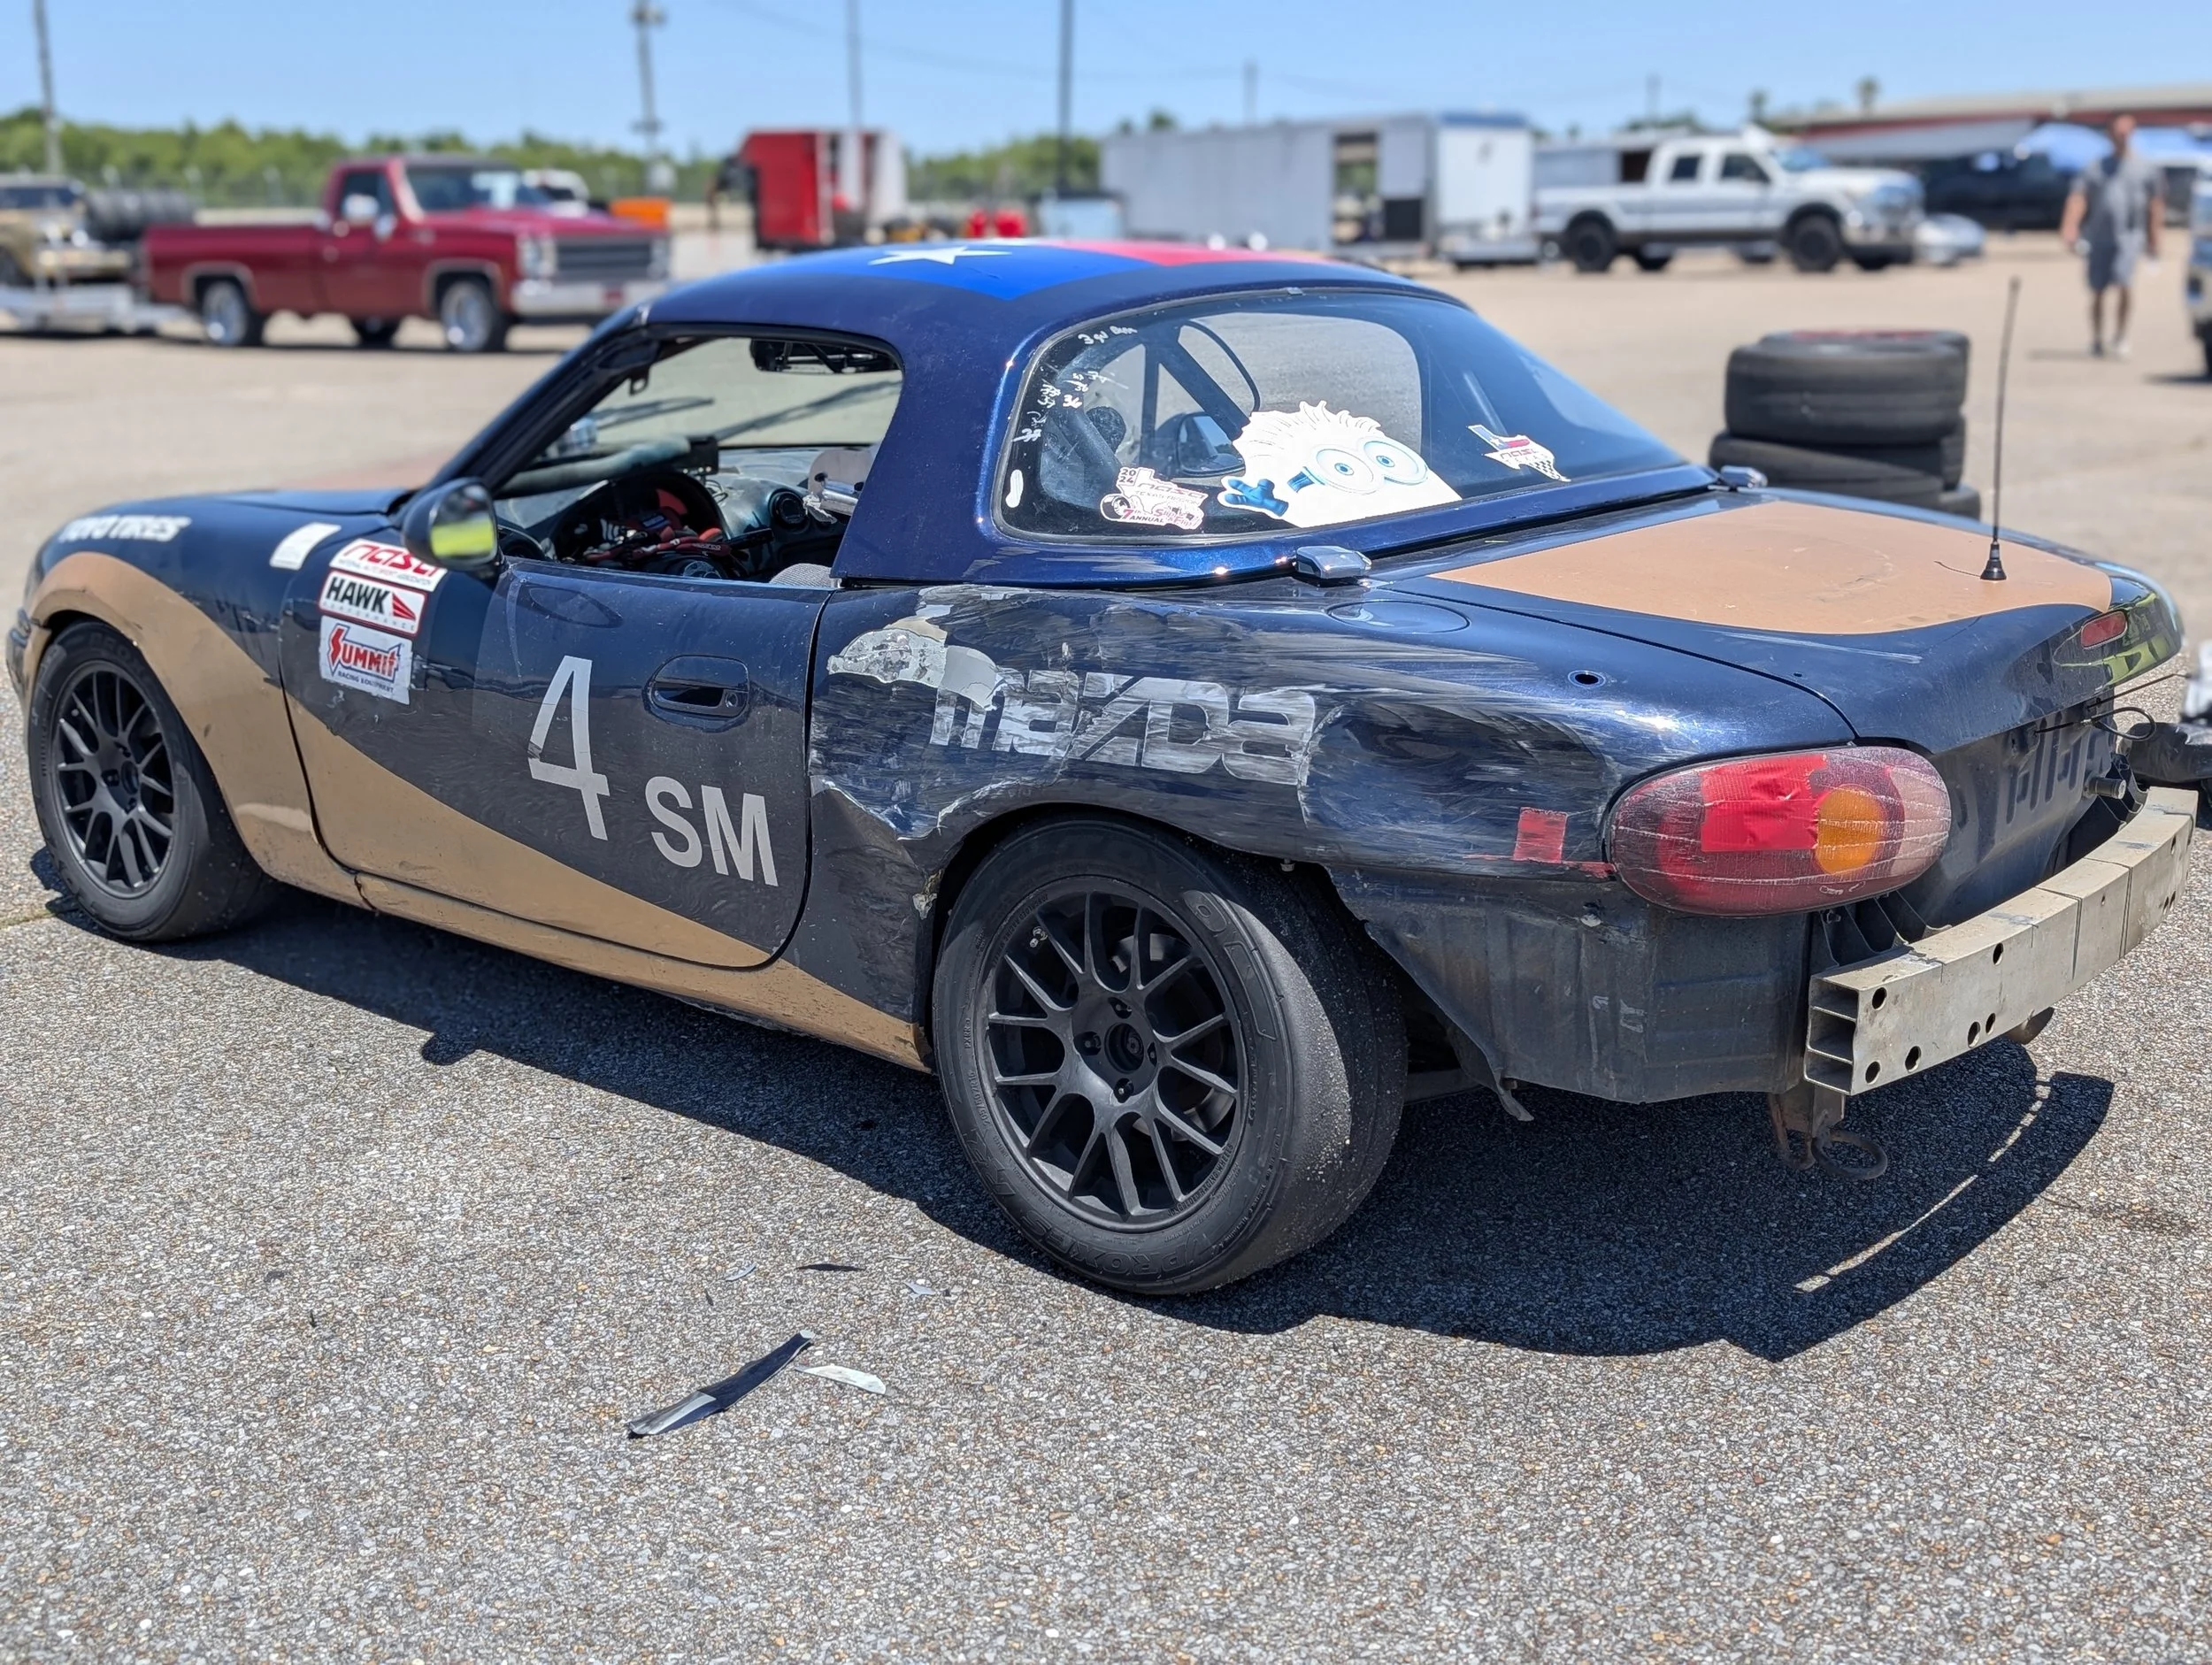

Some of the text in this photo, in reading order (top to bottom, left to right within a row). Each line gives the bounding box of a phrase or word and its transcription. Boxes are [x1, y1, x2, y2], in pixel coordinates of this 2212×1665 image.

[1121, 468, 1137, 477] 20
[1138, 483, 1205, 499] nasa
[343, 543, 440, 577] nasa
[326, 576, 390, 615] HAWK
[338, 670, 359, 683] RACING
[526, 655, 779, 887] 4 SM
[1198, 1171, 1219, 1197] RACING
[1216, 1143, 1233, 1174] WHEELS
[1020, 1208, 1189, 1277] PROXES
